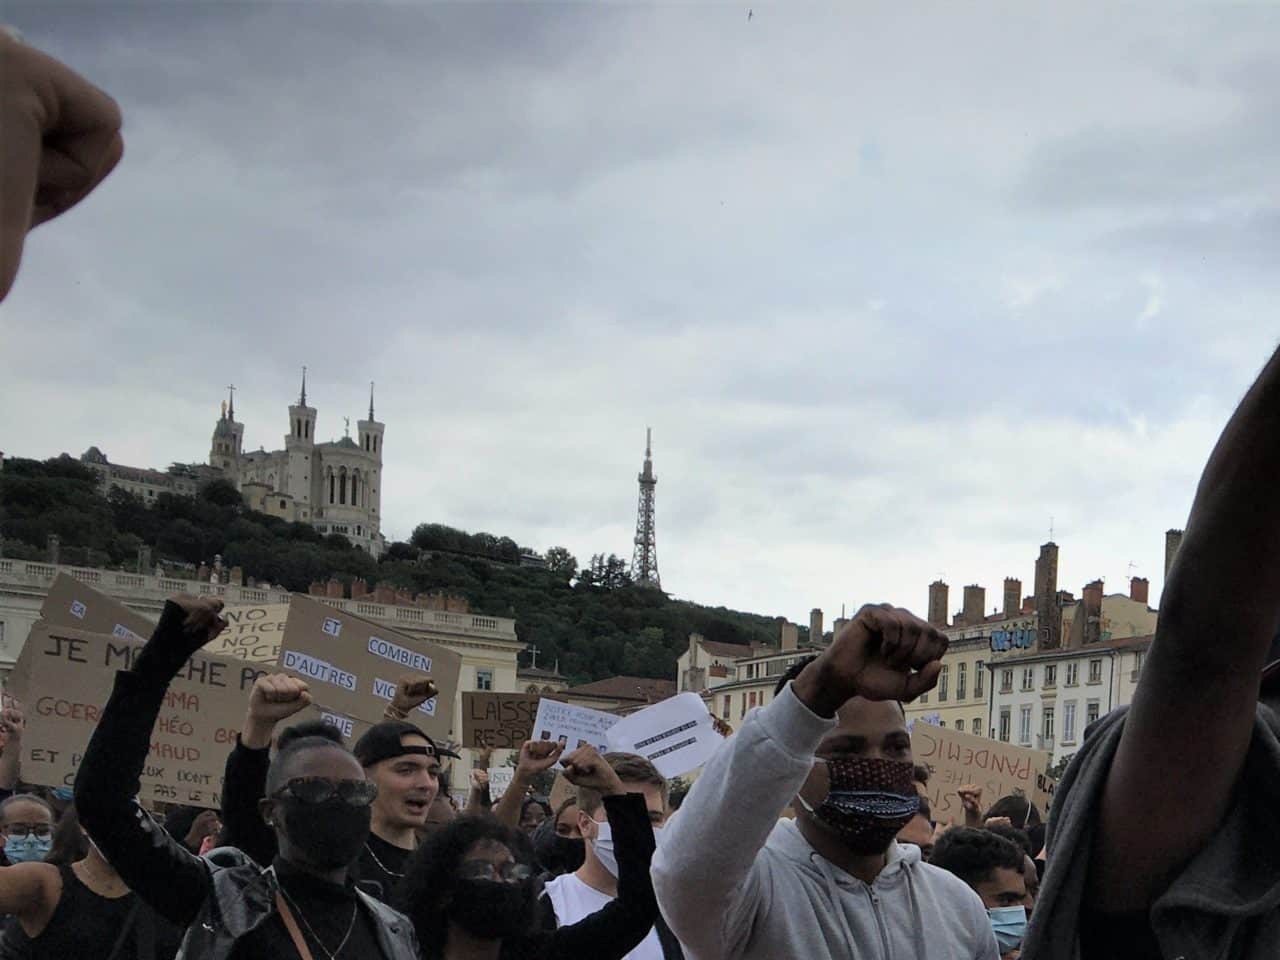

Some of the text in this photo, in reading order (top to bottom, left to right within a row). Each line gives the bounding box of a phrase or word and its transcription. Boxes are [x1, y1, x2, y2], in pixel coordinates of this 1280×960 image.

[225, 609, 267, 627] NO
[324, 619, 341, 635] ET
[43, 634, 89, 663] JE
[222, 635, 260, 648] NO
[369, 639, 431, 670] COMBIEN
[286, 653, 354, 688] D'AUTRES
[36, 696, 103, 722] GOER
[471, 695, 538, 722] LAISSE
[159, 715, 194, 737] HÉO
[474, 727, 531, 749] RESP
[32, 749, 60, 764] ET
[920, 734, 1032, 780] PANDEMIC
